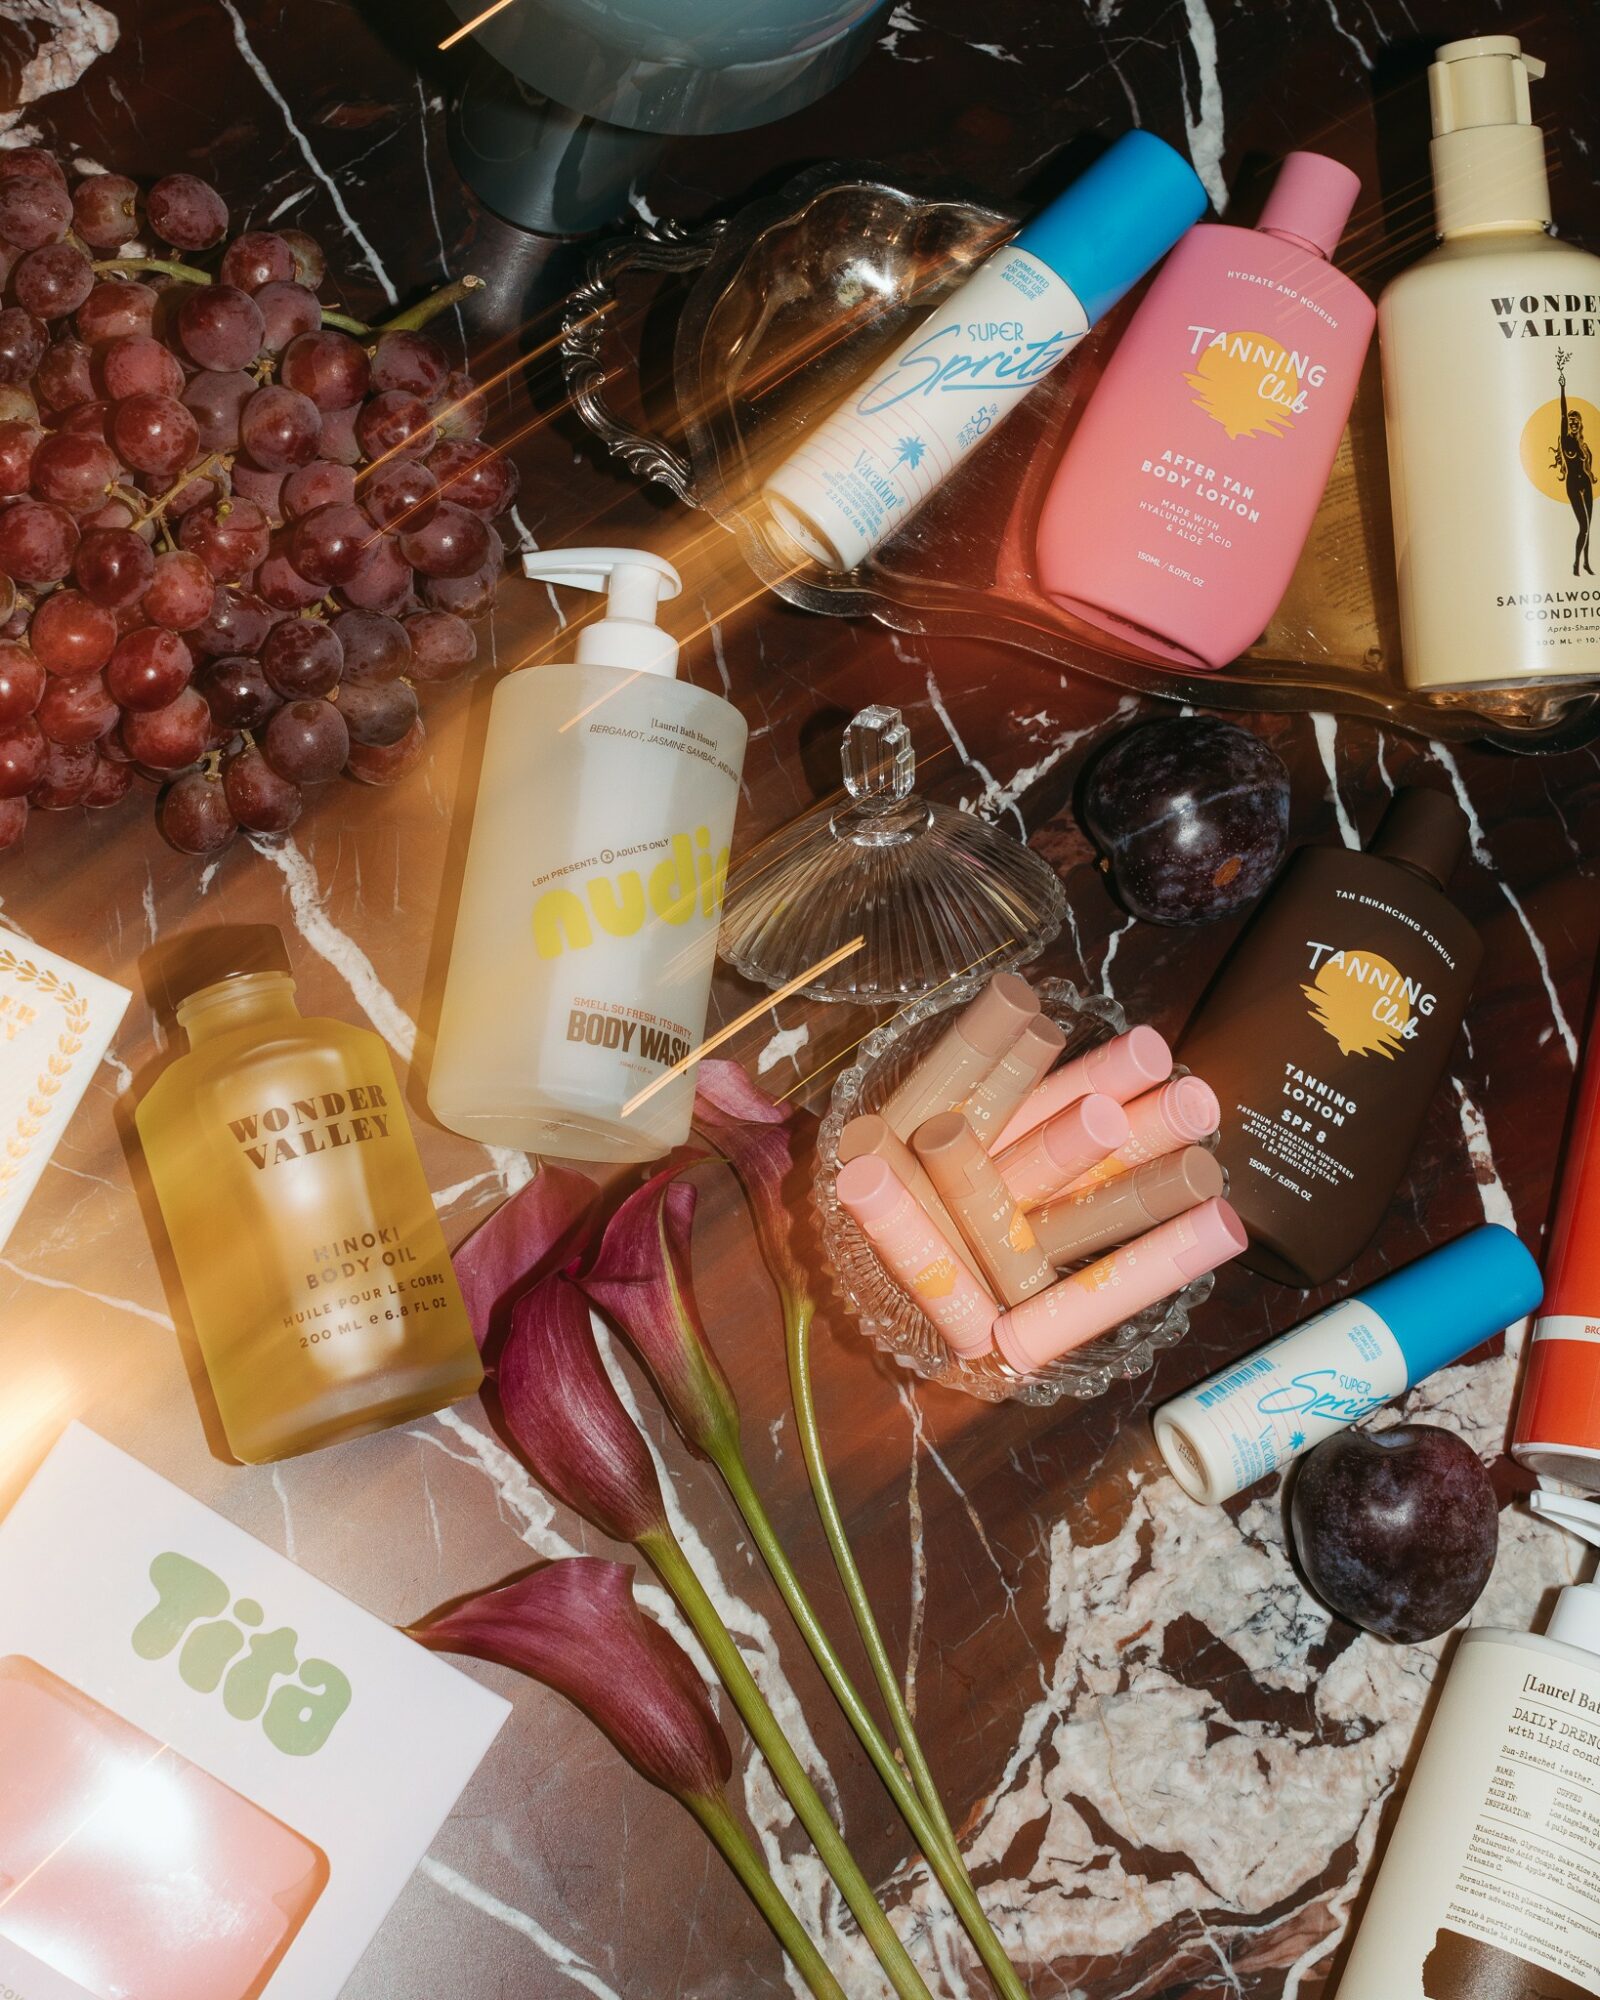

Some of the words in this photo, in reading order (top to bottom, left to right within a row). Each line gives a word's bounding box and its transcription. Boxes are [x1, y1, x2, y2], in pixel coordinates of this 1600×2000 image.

[1227, 270, 1274, 289] HYDRATE
[1276, 284, 1298, 300] AND
[1299, 296, 1339, 330] NOURISH
[1490, 294, 1600, 316] WONDE
[967, 321, 1024, 342] SUPER
[856, 324, 1084, 416] Spritz
[1187, 325, 1328, 388] TANNING
[1257, 373, 1309, 414] Club
[971, 406, 991, 435] 50
[1141, 459, 1191, 489] BODY
[1196, 483, 1260, 523] LOTION
[1161, 450, 1216, 482] AFTER
[1222, 475, 1254, 500] TAN
[1139, 500, 1205, 535] HYALURONIC
[1207, 531, 1232, 549] ACID
[1160, 499, 1191, 517] MADE
[1194, 513, 1220, 531] WITH
[1166, 524, 1173, 532] &
[1177, 528, 1204, 545] ALOE
[1137, 551, 1162, 568] 150ML
[589, 723, 646, 743] BERGAMOT,
[647, 733, 687, 752] JASMINE
[686, 744, 717, 768] SAMBAC,
[716, 760, 730, 774] AND
[679, 726, 696, 740] Bath
[531, 875, 551, 888] LBH
[550, 857, 599, 879] PRESENTS
[616, 843, 648, 859] ADULTS
[649, 838, 670, 850] ONLY
[1335, 889, 1356, 901] TAN
[1358, 895, 1422, 932] ENHANCHING
[1421, 929, 1456, 971] FORMULA
[1306, 940, 1438, 1017] TANNING
[573, 997, 610, 1012] SMELL
[611, 1003, 625, 1016] SO
[658, 1018, 673, 1030] ITS
[672, 1022, 693, 1040] DIRTY
[1371, 995, 1420, 1040] Club
[566, 1010, 637, 1053] BODY
[640, 1024, 691, 1075] WASH
[1282, 1082, 1345, 1127] LOTION
[1285, 1062, 1357, 1115] TANNING
[227, 1084, 388, 1144] WONDER
[974, 1105, 991, 1120] 30
[1281, 1109, 1313, 1133] SPF
[1316, 1130, 1327, 1144] 8
[243, 1113, 391, 1170] VALLEY
[1236, 1104, 1272, 1126] PREMIUM
[1273, 1123, 1315, 1152] HYDRATING
[1316, 1149, 1355, 1180] SUNSCREEN
[1242, 1123, 1268, 1141] WATER
[1277, 1142, 1302, 1161] SWEAT
[1302, 1158, 1340, 1186] RESISTANT
[1250, 1119, 1278, 1137] BROAD
[1279, 1135, 1320, 1162] SPECTRUM
[1318, 1159, 1331, 1171] SPF
[1248, 1157, 1272, 1177] 150ML
[1279, 1152, 1310, 1176] MINUTES
[992, 1200, 1010, 1222] SPF
[312, 1226, 400, 1264] HINOKI
[306, 1256, 370, 1290] BODY
[382, 1247, 417, 1267] OIL
[283, 1303, 332, 1329] HUILE
[338, 1287, 382, 1310] POUR
[388, 1281, 405, 1295] LE
[410, 1273, 444, 1290] CORPS
[299, 1328, 332, 1349] 200
[338, 1319, 363, 1336] ML
[384, 1305, 409, 1321] 6.8
[414, 1300, 429, 1313] FL
[432, 1296, 448, 1309] OZ
[1339, 1374, 1372, 1395] SUPER
[1522, 1673, 1577, 1704] [Laurel
[1512, 1707, 1558, 1731] DAILY
[1501, 1744, 1556, 1770] Sun-Bleached
[1508, 1725, 1535, 1740] with
[1537, 1733, 1571, 1753] lipid
[1491, 1776, 1516, 1790] SCENT:
[1495, 1765, 1516, 1778] NAME:
[1484, 1798, 1532, 1820] INSPIRATION:
[1488, 1787, 1506, 1799] MADE
[1455, 1884, 1469, 1893] our
[1458, 1872, 1502, 1894] Formulated
[1445, 1913, 1467, 1925] notre
